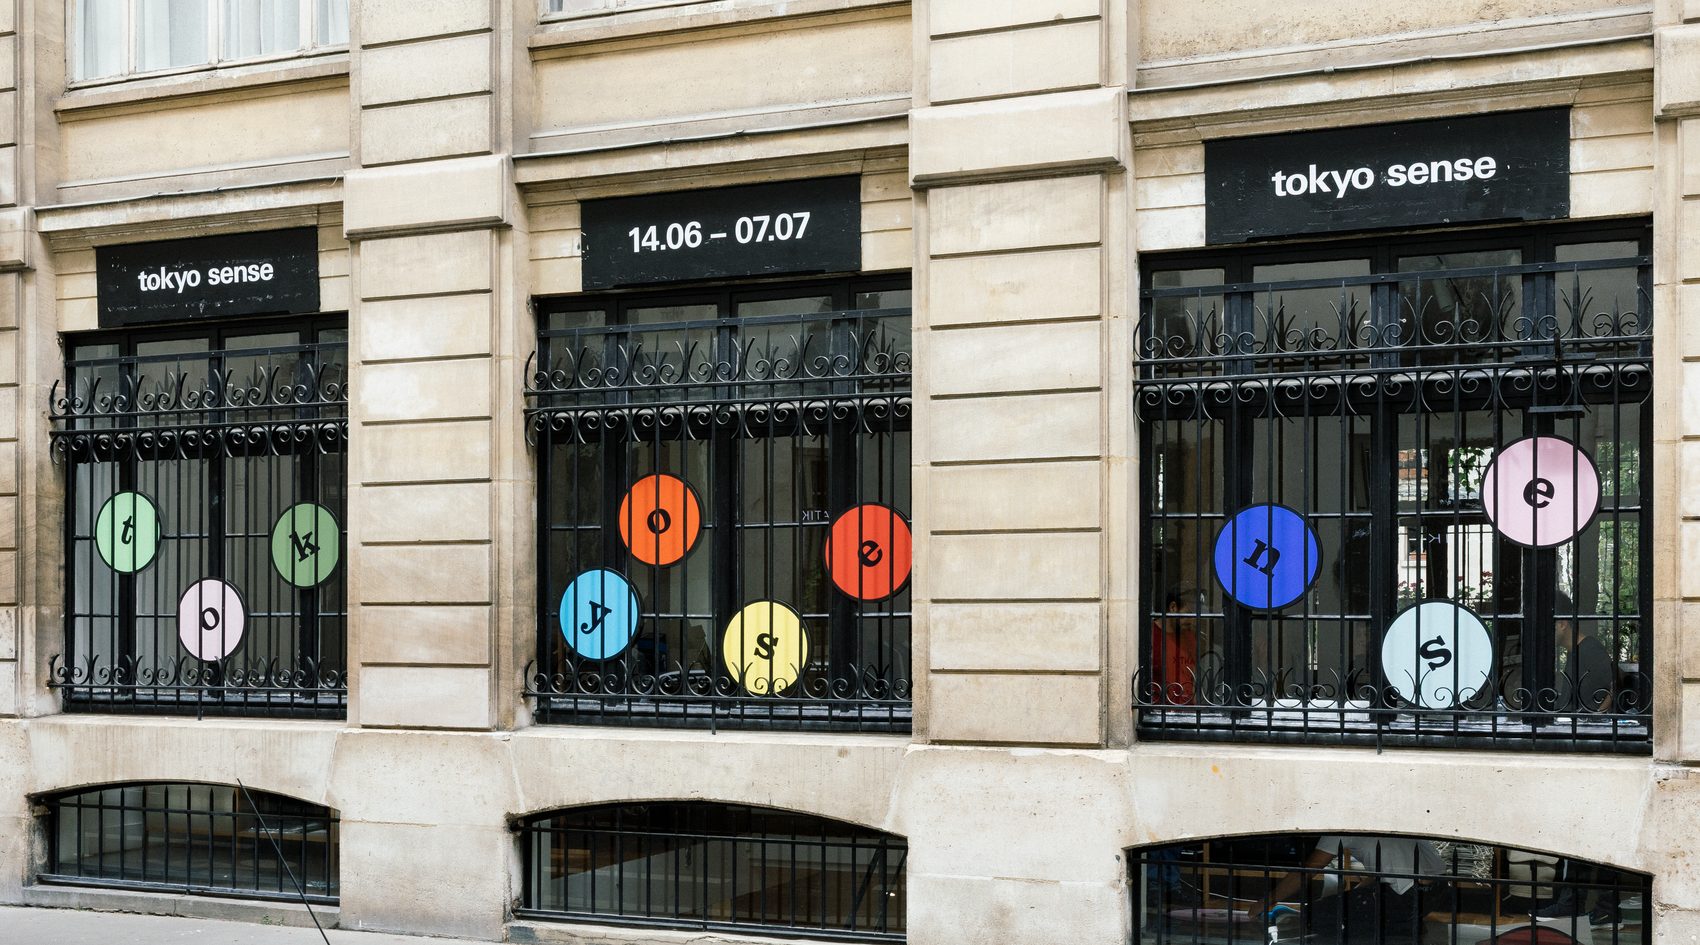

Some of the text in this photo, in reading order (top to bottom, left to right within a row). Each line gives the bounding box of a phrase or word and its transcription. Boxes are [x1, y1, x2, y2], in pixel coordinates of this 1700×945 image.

[1272, 156, 1497, 198] tokyo sense
[628, 221, 703, 253] 14.06
[735, 211, 811, 244] 07.07
[137, 263, 274, 293] tokyo sense
[1523, 478, 1555, 509] e
[121, 515, 135, 545] t
[647, 508, 671, 535] o
[289, 531, 321, 562] k
[858, 540, 883, 567] e
[1243, 538, 1280, 578] n
[201, 607, 220, 630] o
[581, 600, 612, 634] y
[754, 632, 779, 660] s
[1420, 635, 1452, 671] s
